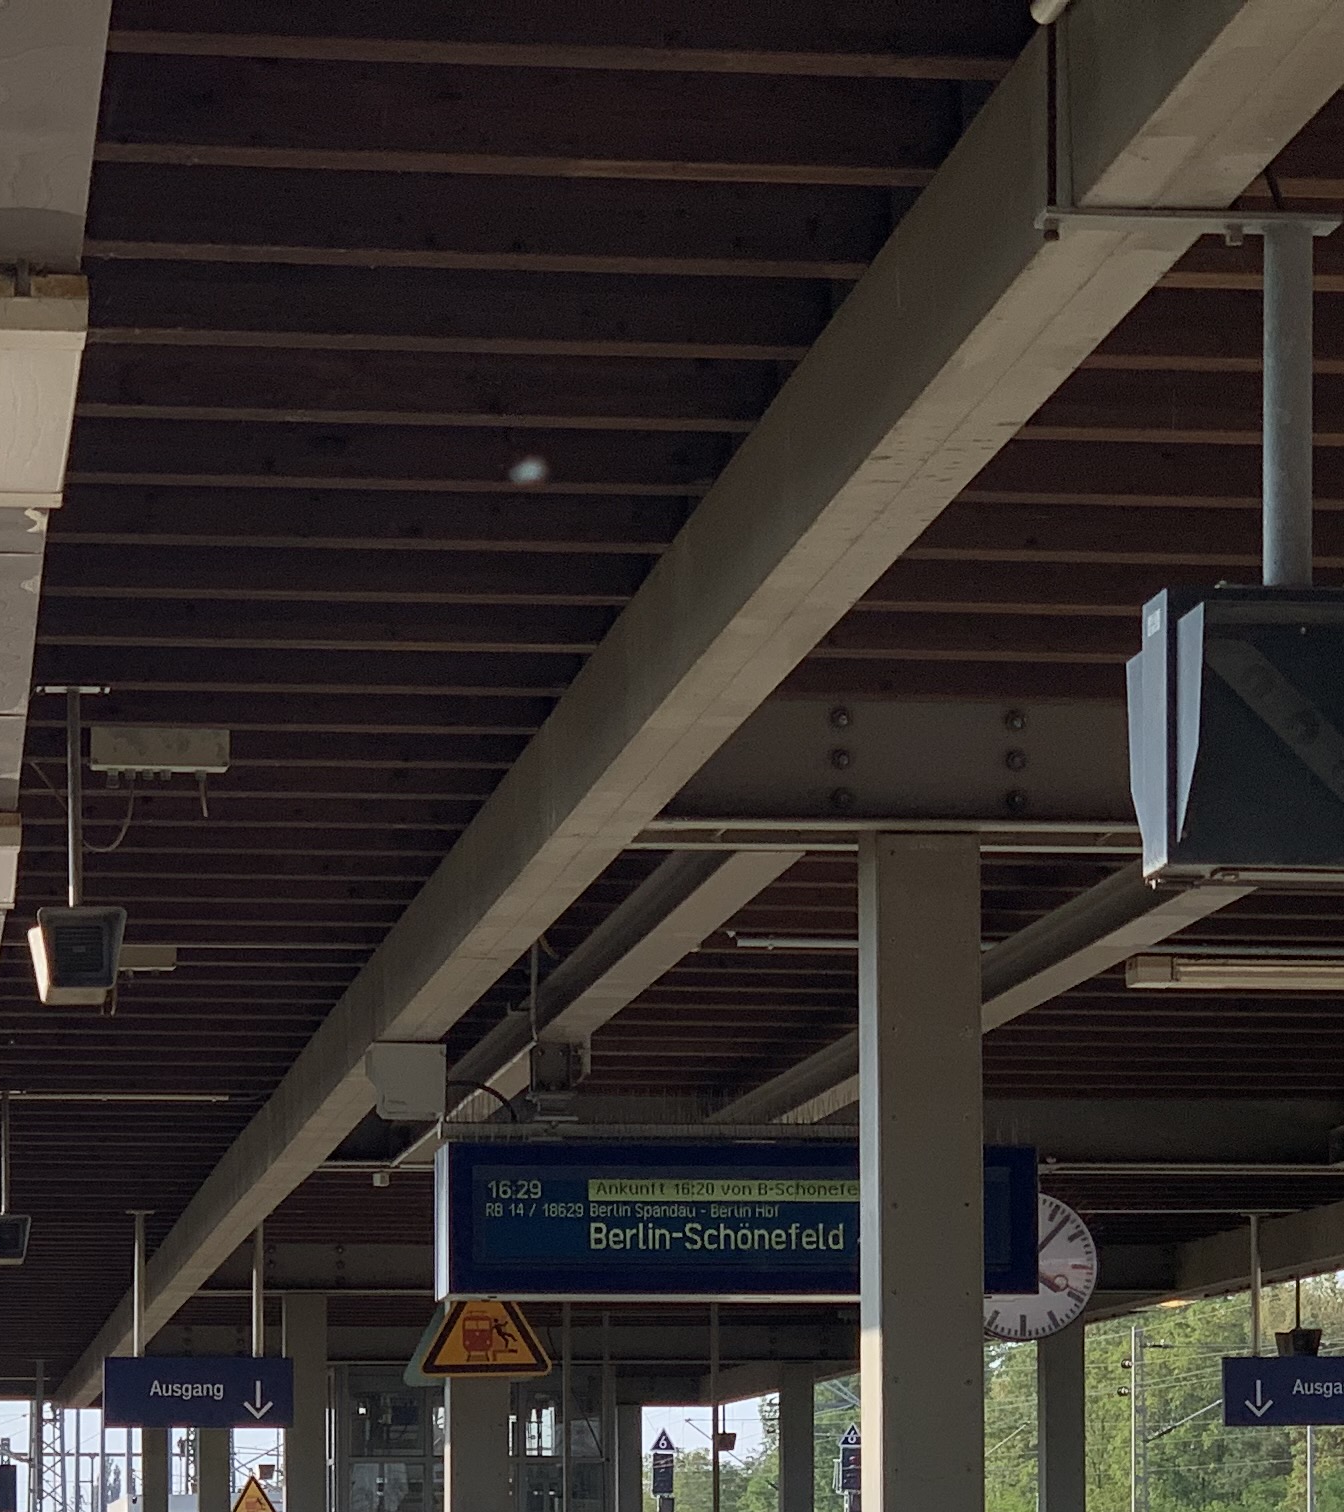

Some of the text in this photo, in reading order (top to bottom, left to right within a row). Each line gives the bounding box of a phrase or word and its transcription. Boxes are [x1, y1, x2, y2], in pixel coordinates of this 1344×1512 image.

[488, 1180, 542, 1199] 16:29
[596, 1181, 665, 1196] Ankunft
[674, 1181, 714, 1196] 16:20
[721, 1184, 752, 1196] von
[486, 1203, 585, 1217] RB 14 / 18629
[589, 1203, 632, 1218] Berlin
[635, 1203, 697, 1221] Spandau
[710, 1203, 752, 1218] Berlin
[756, 1203, 780, 1218] Hbf
[589, 1221, 845, 1251] Berlin-Schönefeld
[149, 1379, 224, 1400] Ausgang
[658, 1435, 668, 1449] 6
